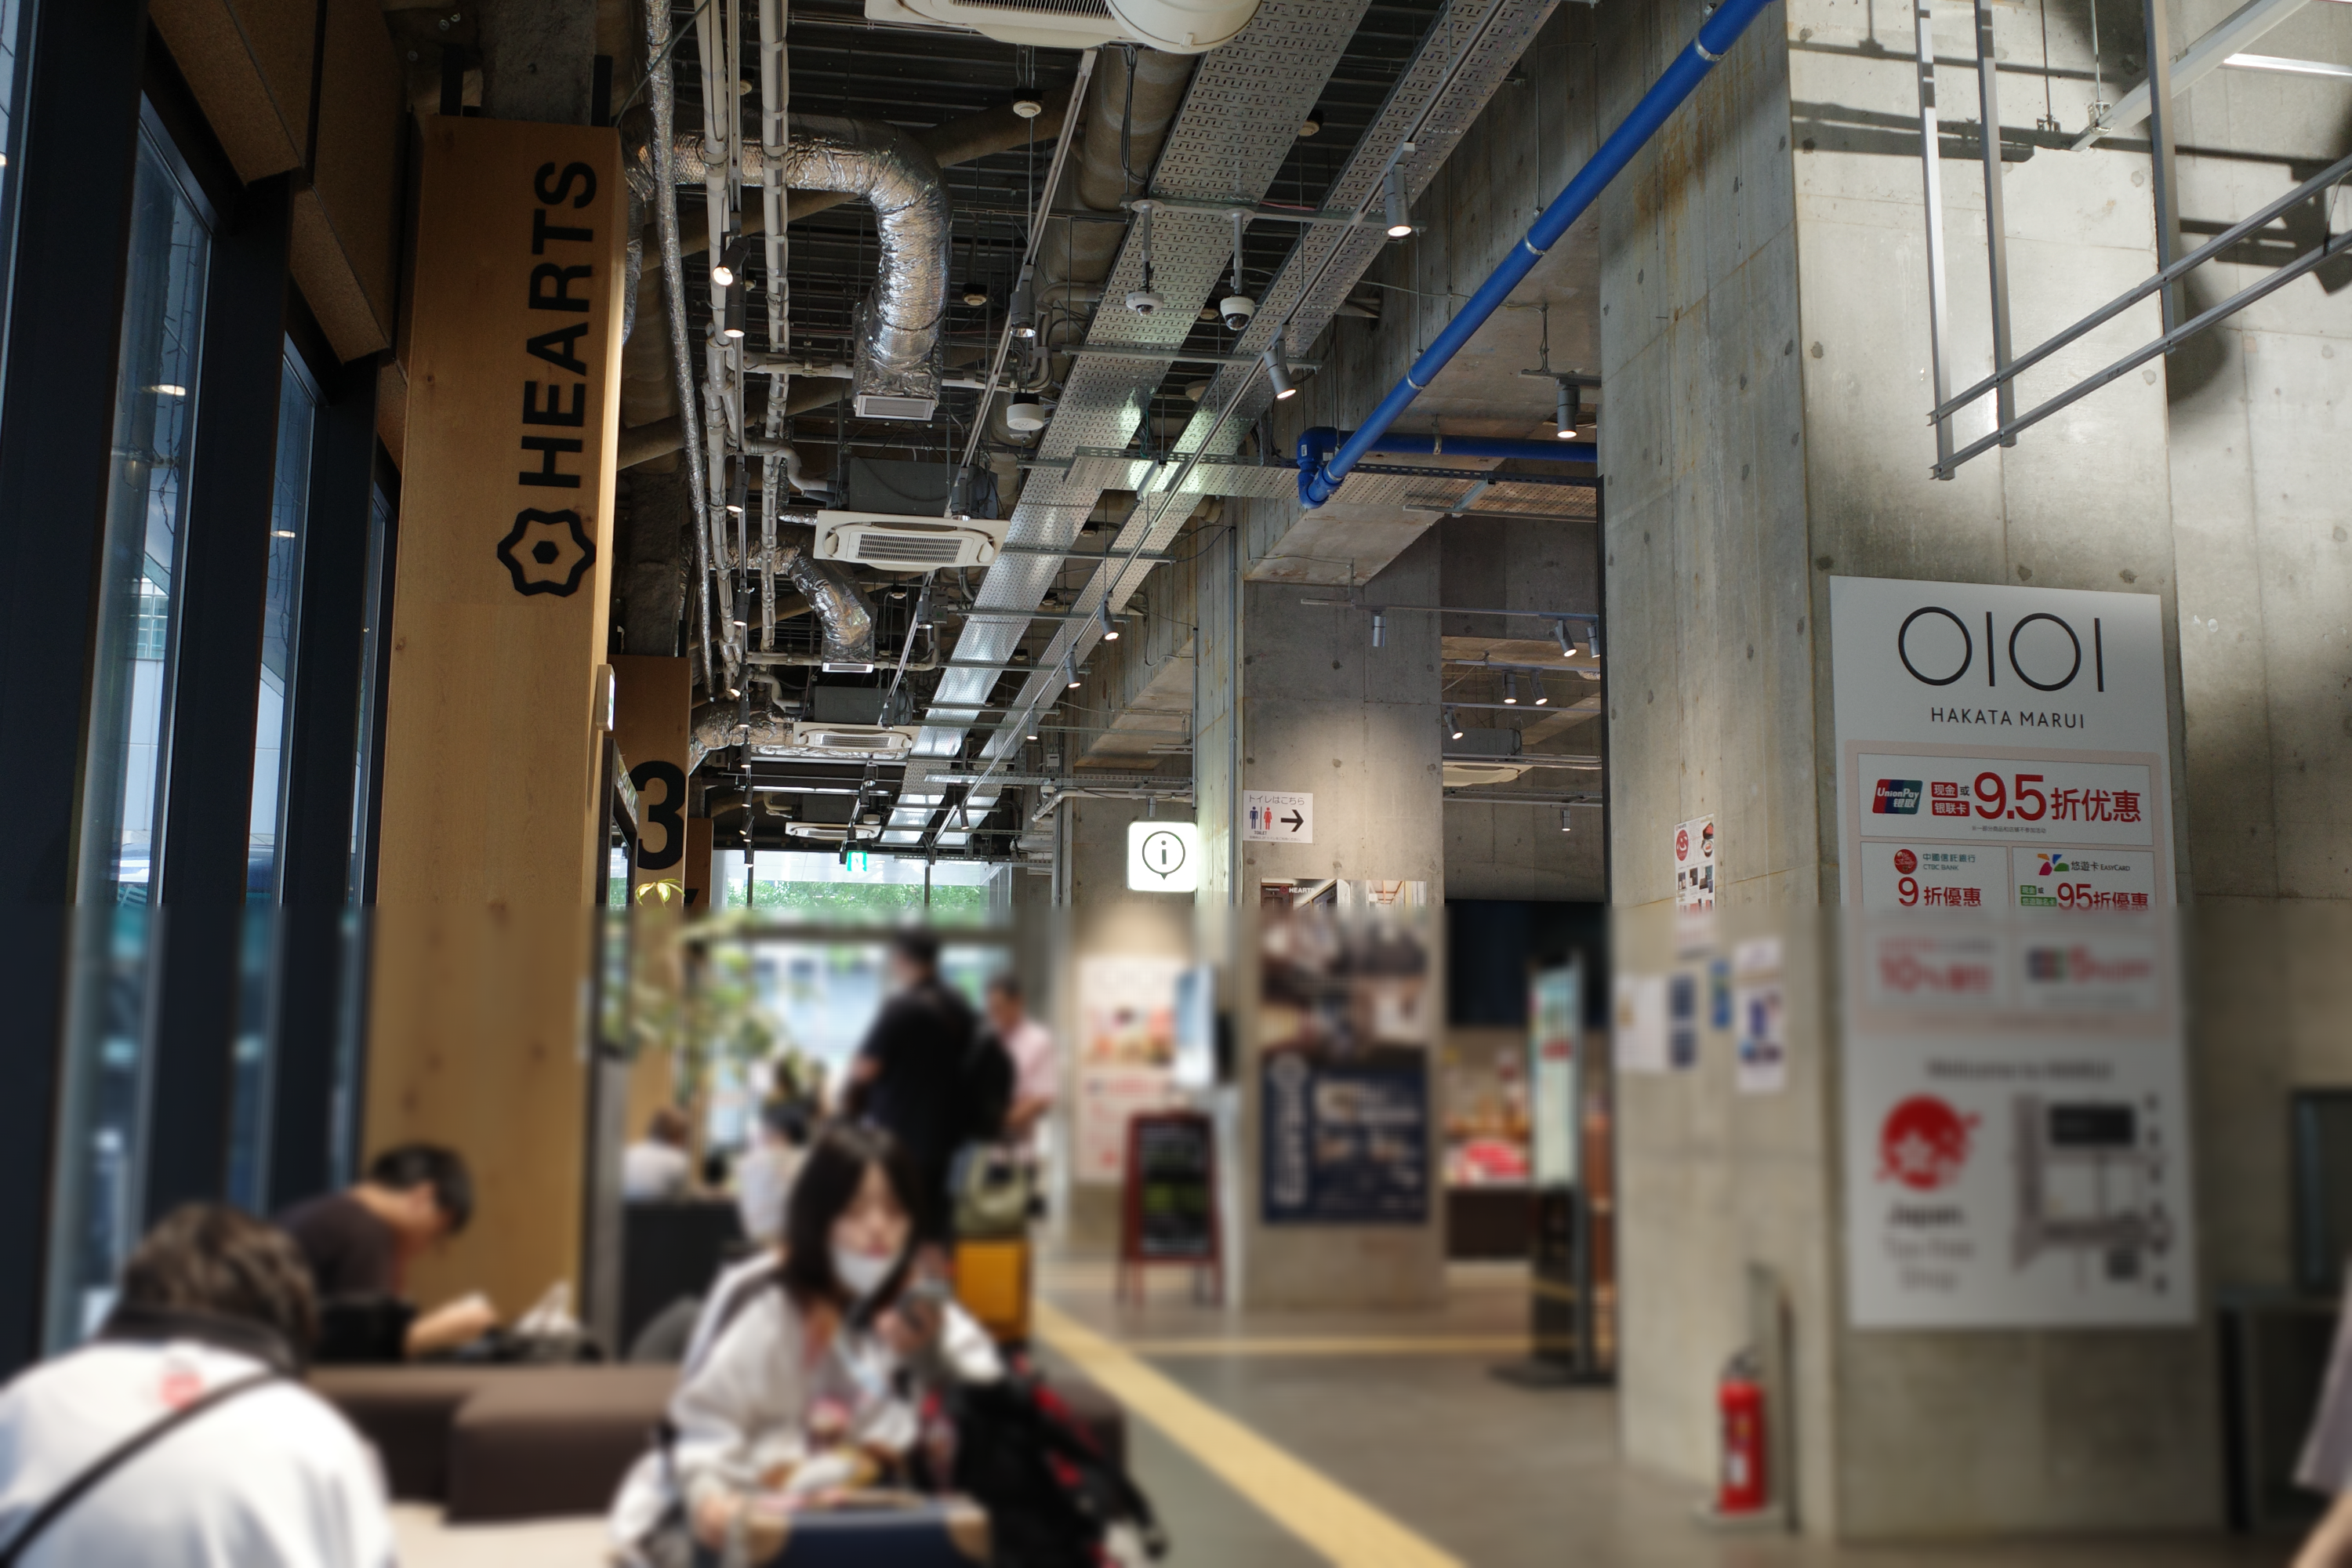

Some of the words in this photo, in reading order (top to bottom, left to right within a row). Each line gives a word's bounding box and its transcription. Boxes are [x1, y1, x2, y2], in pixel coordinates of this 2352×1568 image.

[519, 162, 597, 488] HEARTS
[1932, 707, 2013, 726] HAKATA
[2020, 711, 2085, 728] MARUI
[1249, 794, 1305, 806] トイレはこちら
[1877, 787, 1920, 801] UnionPay
[1893, 798, 1915, 808] 银联
[1934, 801, 1967, 815] 银联卡
[630, 760, 686, 870] 3
[1922, 853, 1976, 863] 中國信託銀行
[2071, 861, 2100, 871] 悠遊卡
